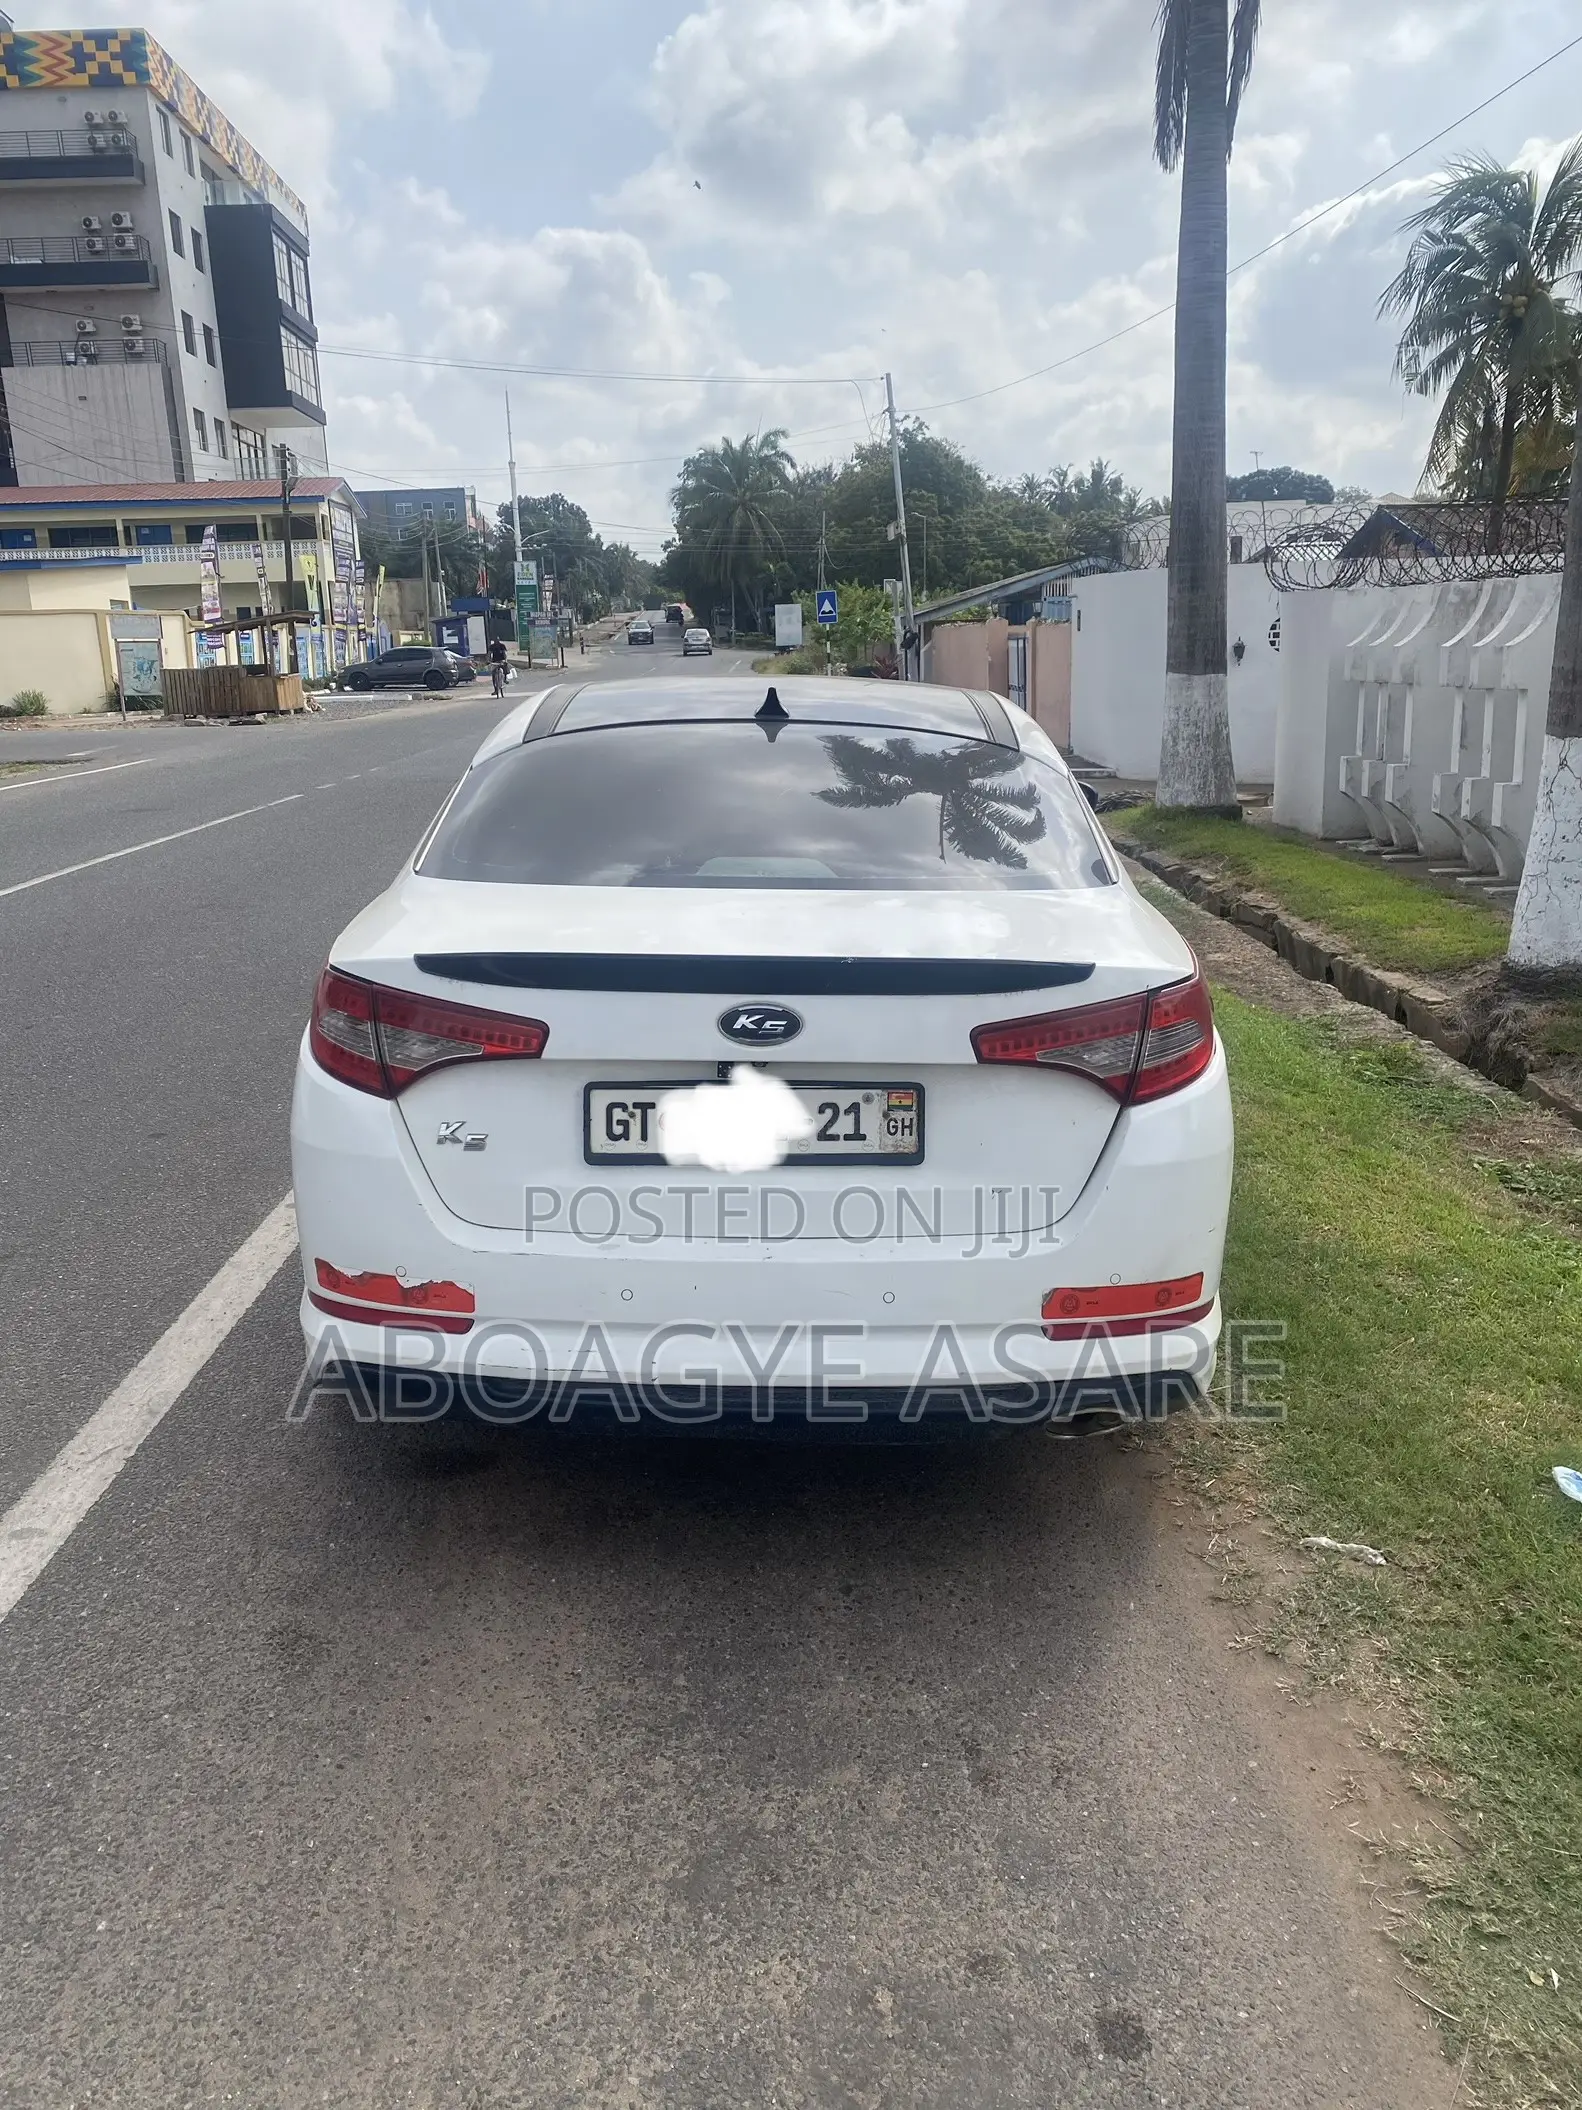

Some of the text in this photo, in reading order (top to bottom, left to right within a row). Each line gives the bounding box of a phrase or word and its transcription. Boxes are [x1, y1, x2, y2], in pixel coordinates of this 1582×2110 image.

[733, 1014, 788, 1034] K5
[605, 1102, 867, 1142] GT 21
[886, 1117, 914, 1137] GH
[436, 1121, 489, 1151] K5
